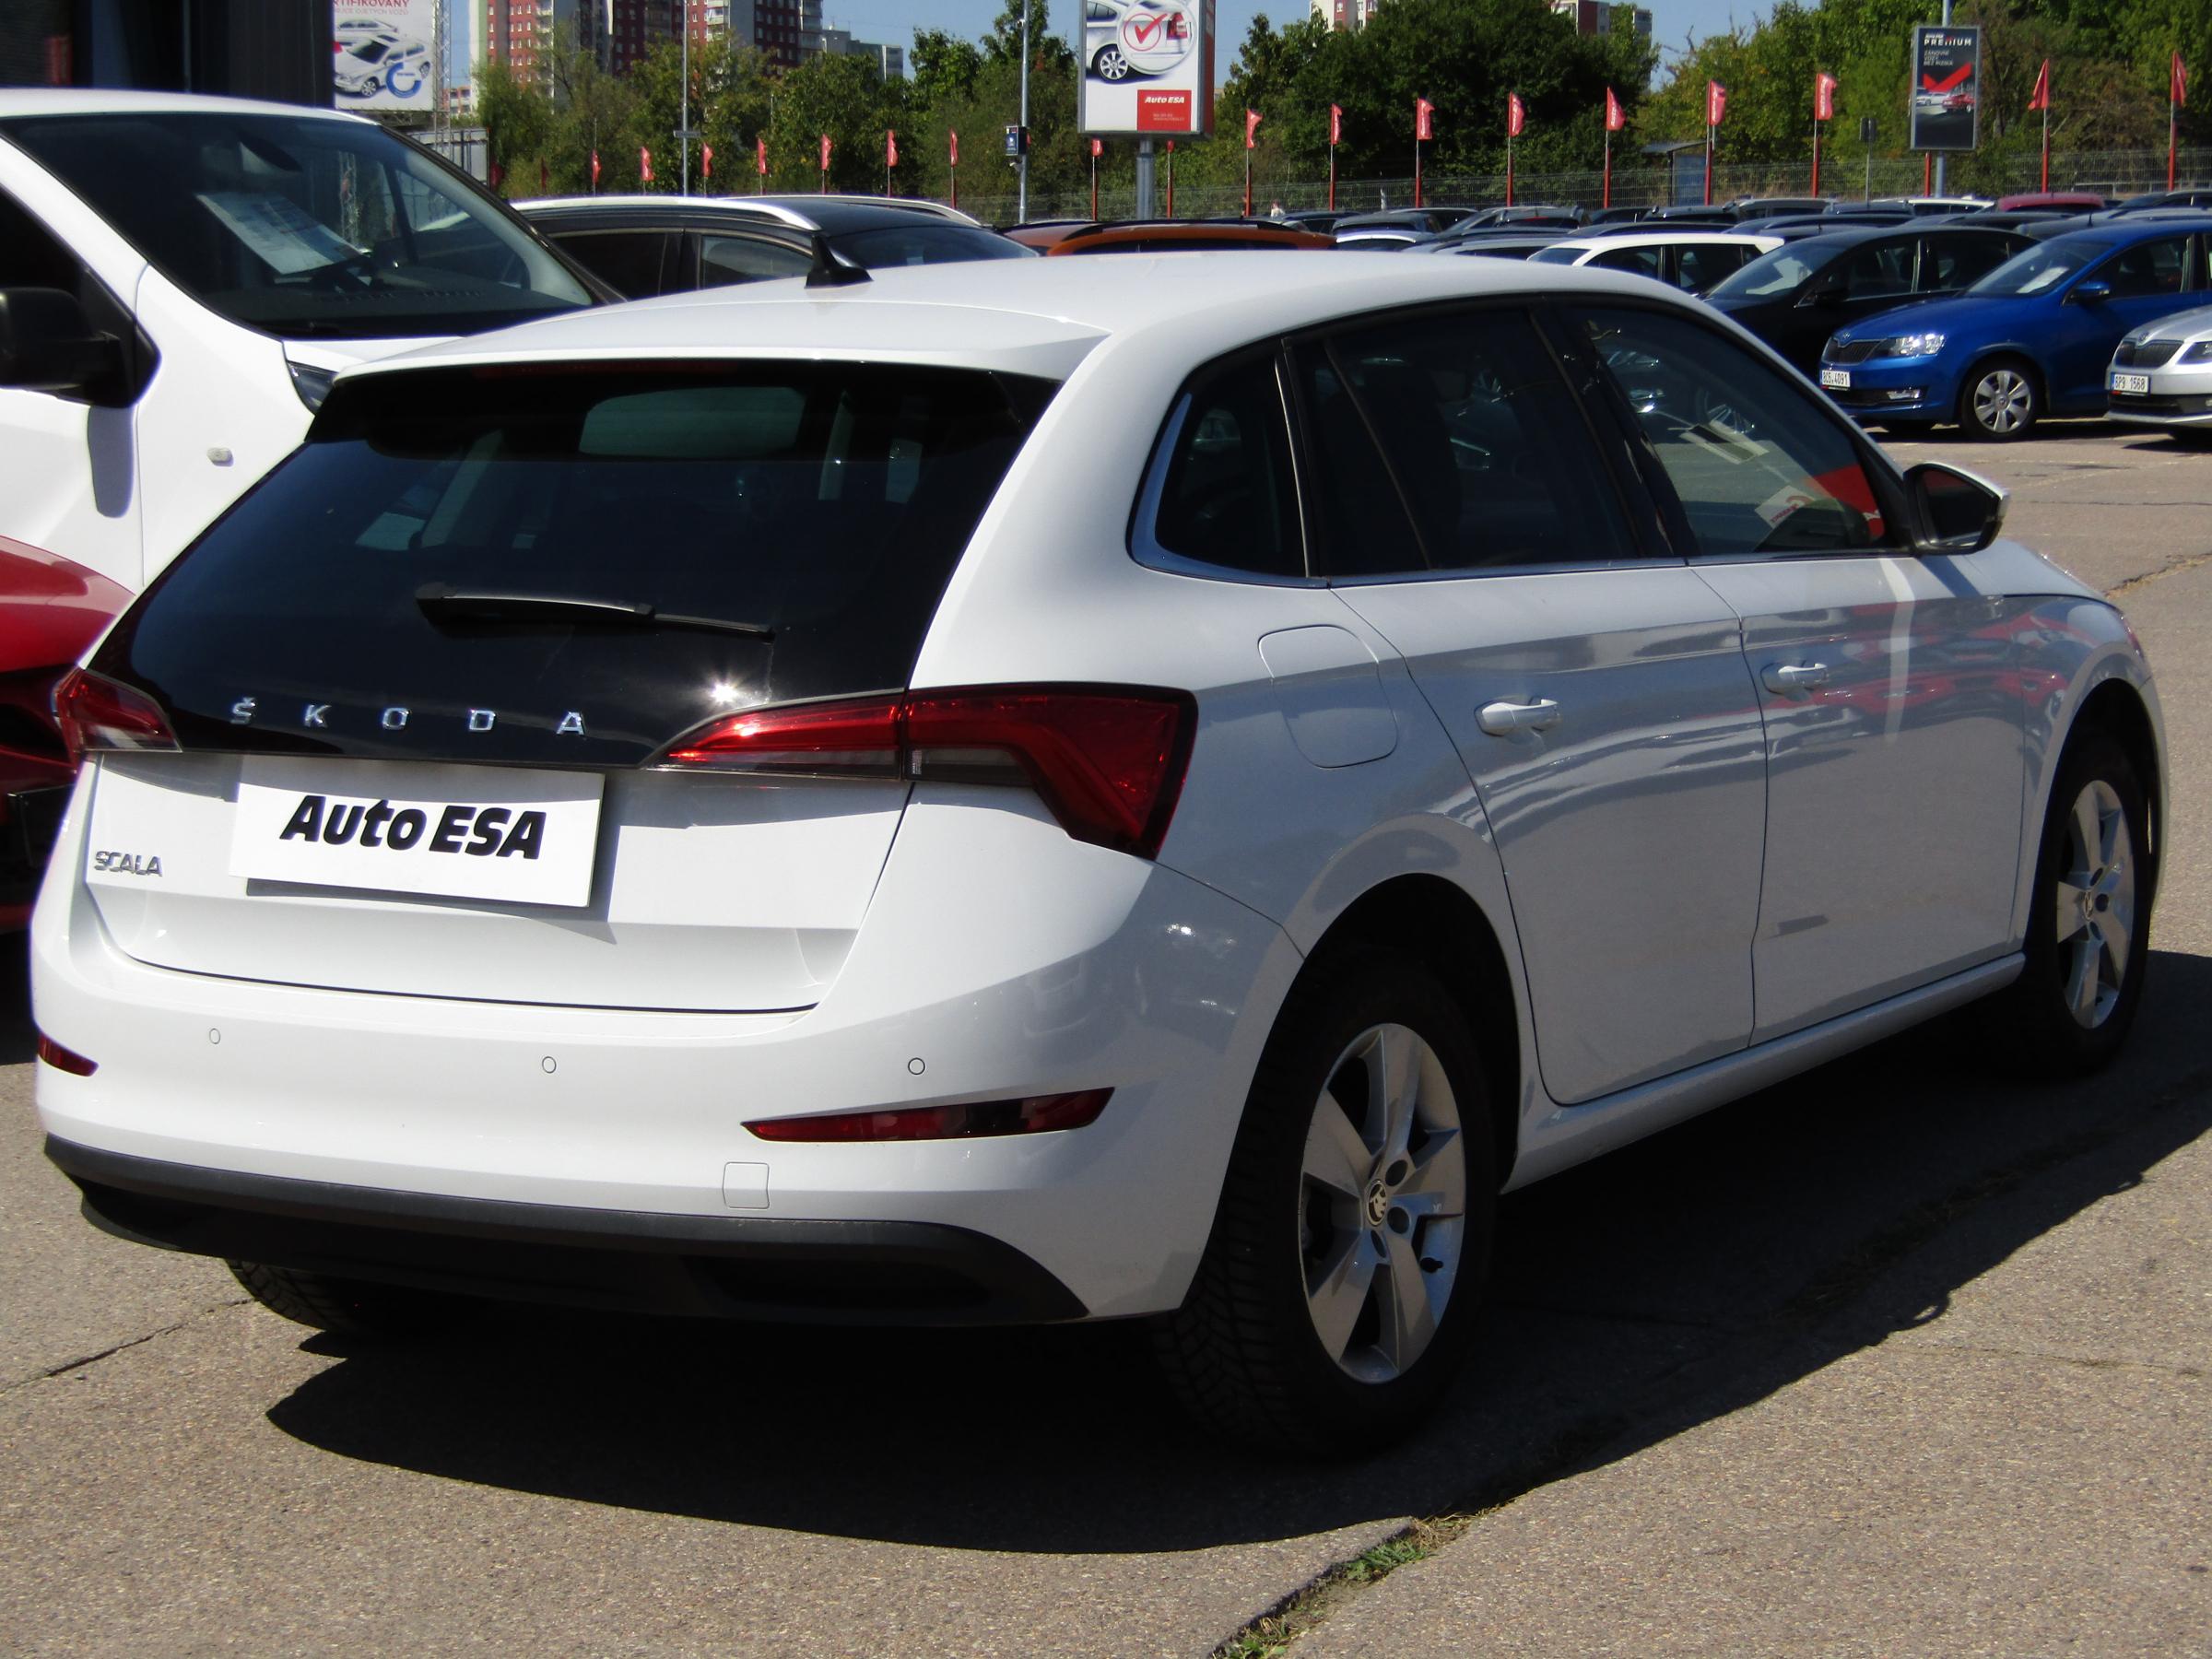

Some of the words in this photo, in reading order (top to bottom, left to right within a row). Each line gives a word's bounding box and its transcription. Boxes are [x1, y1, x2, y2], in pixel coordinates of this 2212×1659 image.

[1924, 36, 1971, 46] PREMIUM
[2130, 377, 2146, 390] 1568
[229, 696, 586, 736] ŠKODA
[279, 794, 428, 851] Auto
[429, 805, 547, 860] ESA
[94, 851, 163, 877] SCALA
